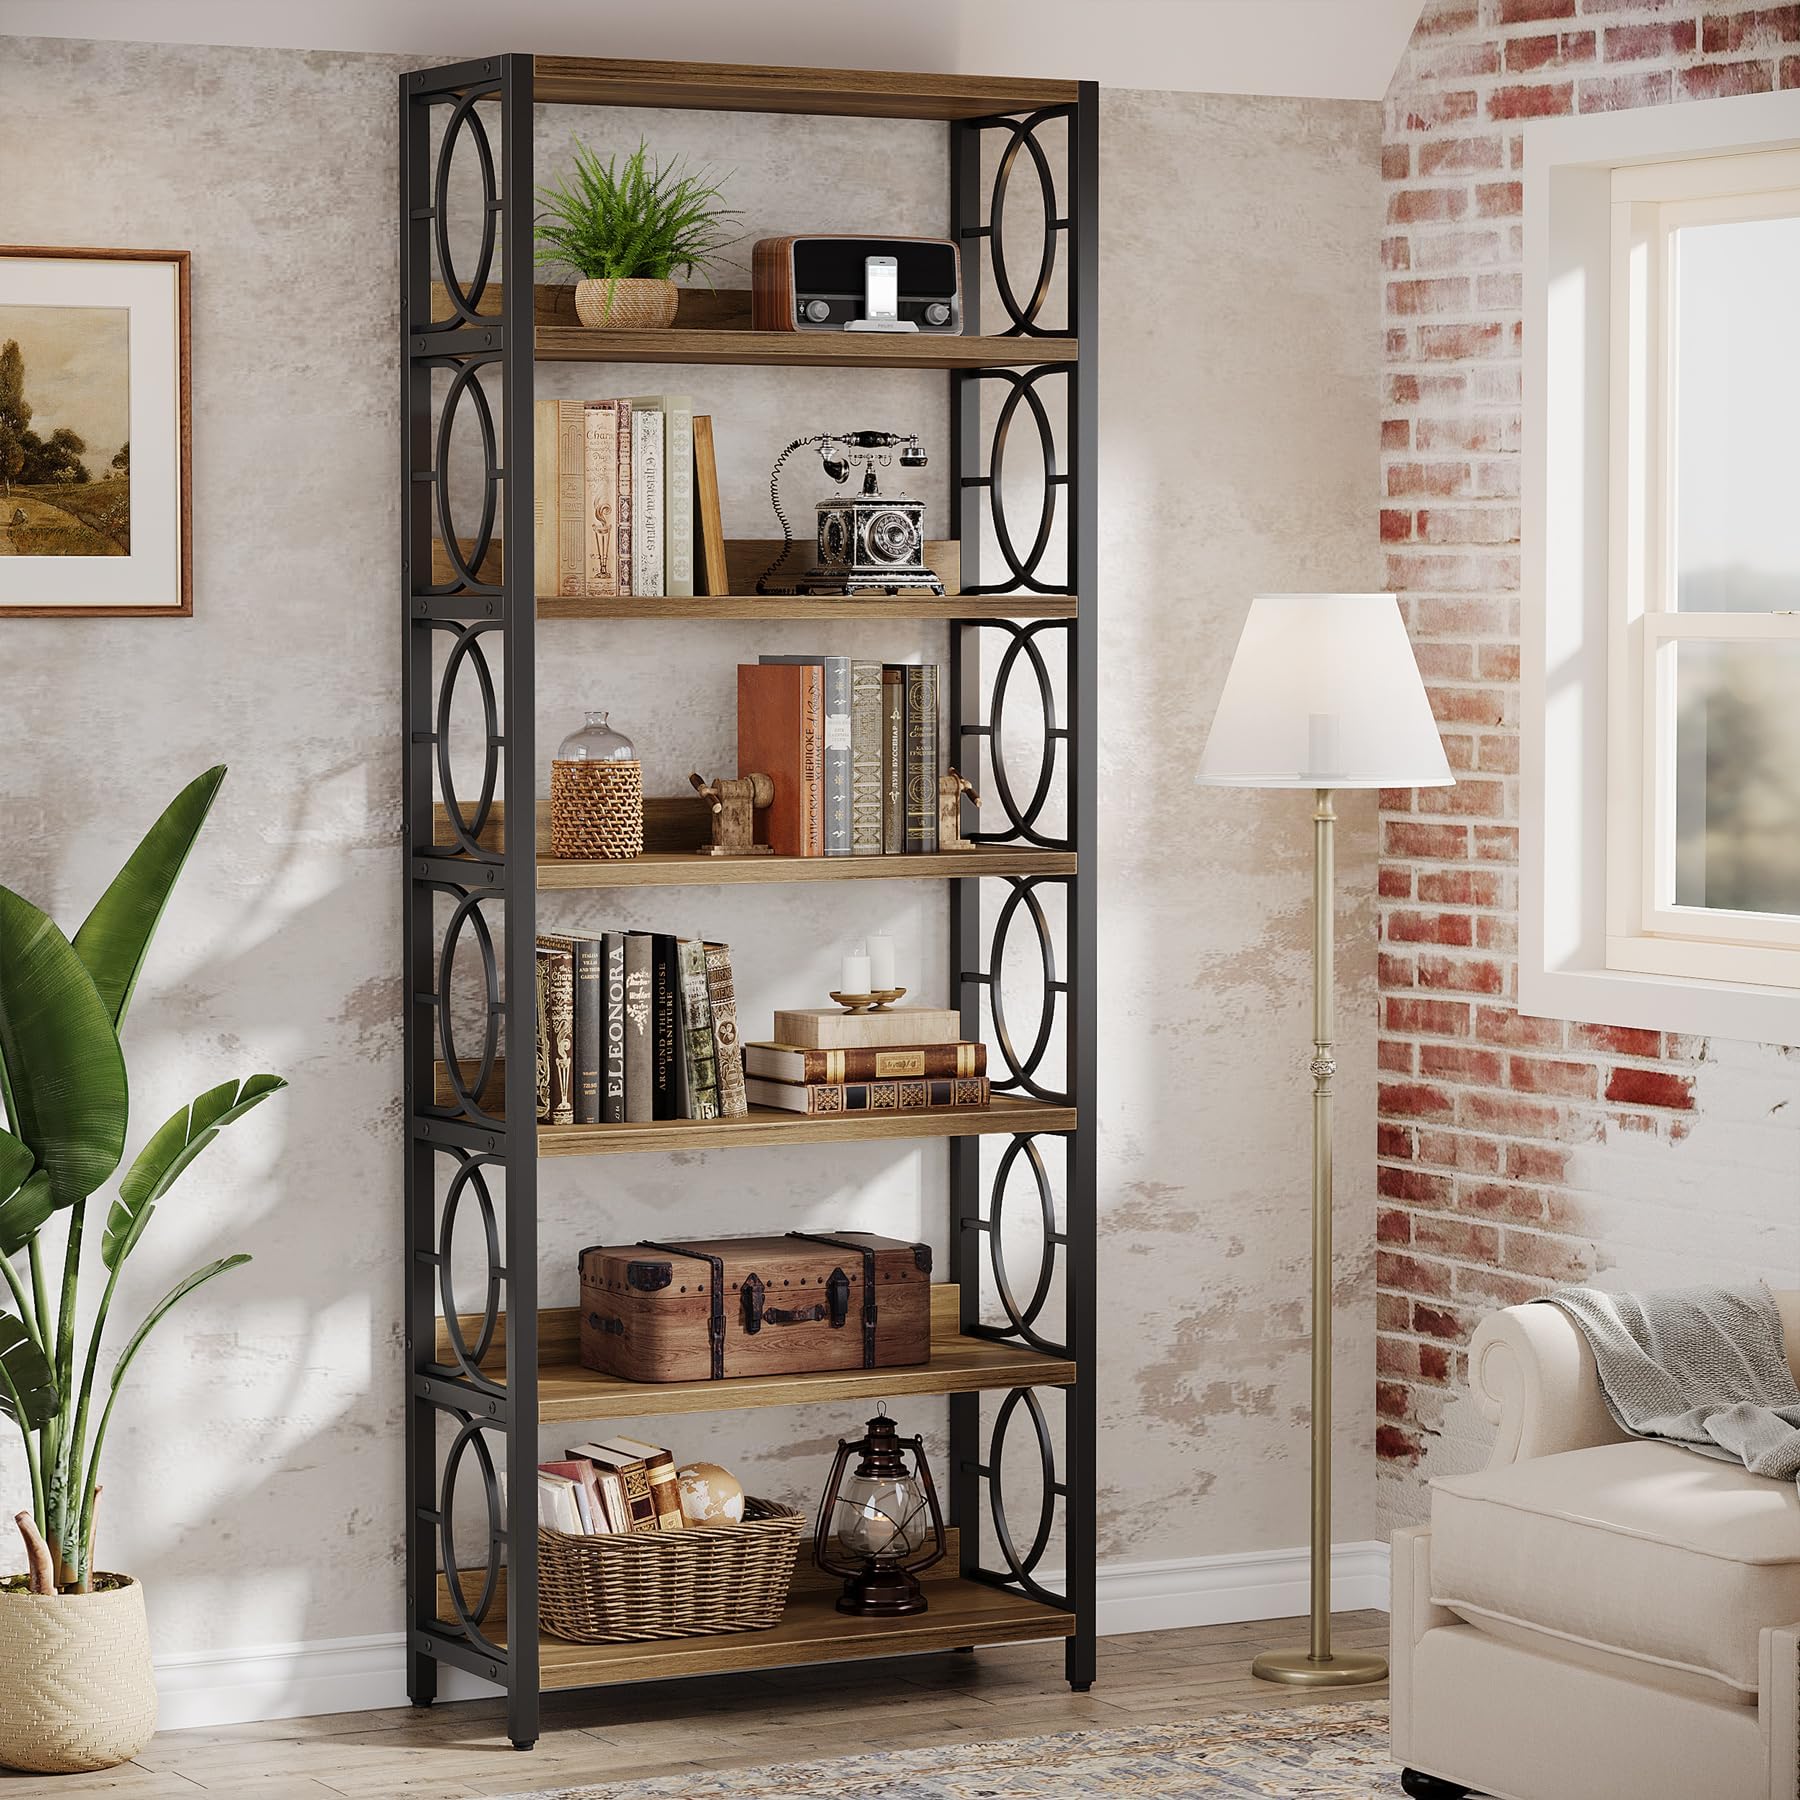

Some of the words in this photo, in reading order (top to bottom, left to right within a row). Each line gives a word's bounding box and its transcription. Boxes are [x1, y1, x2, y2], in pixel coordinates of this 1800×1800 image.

[804, 729, 815, 782] ШЕРЛОКЕ
[809, 794, 818, 848] ЗАПИСКИ
[608, 945, 624, 1098] ELEONORA
[658, 1039, 666, 1091] AROUND
